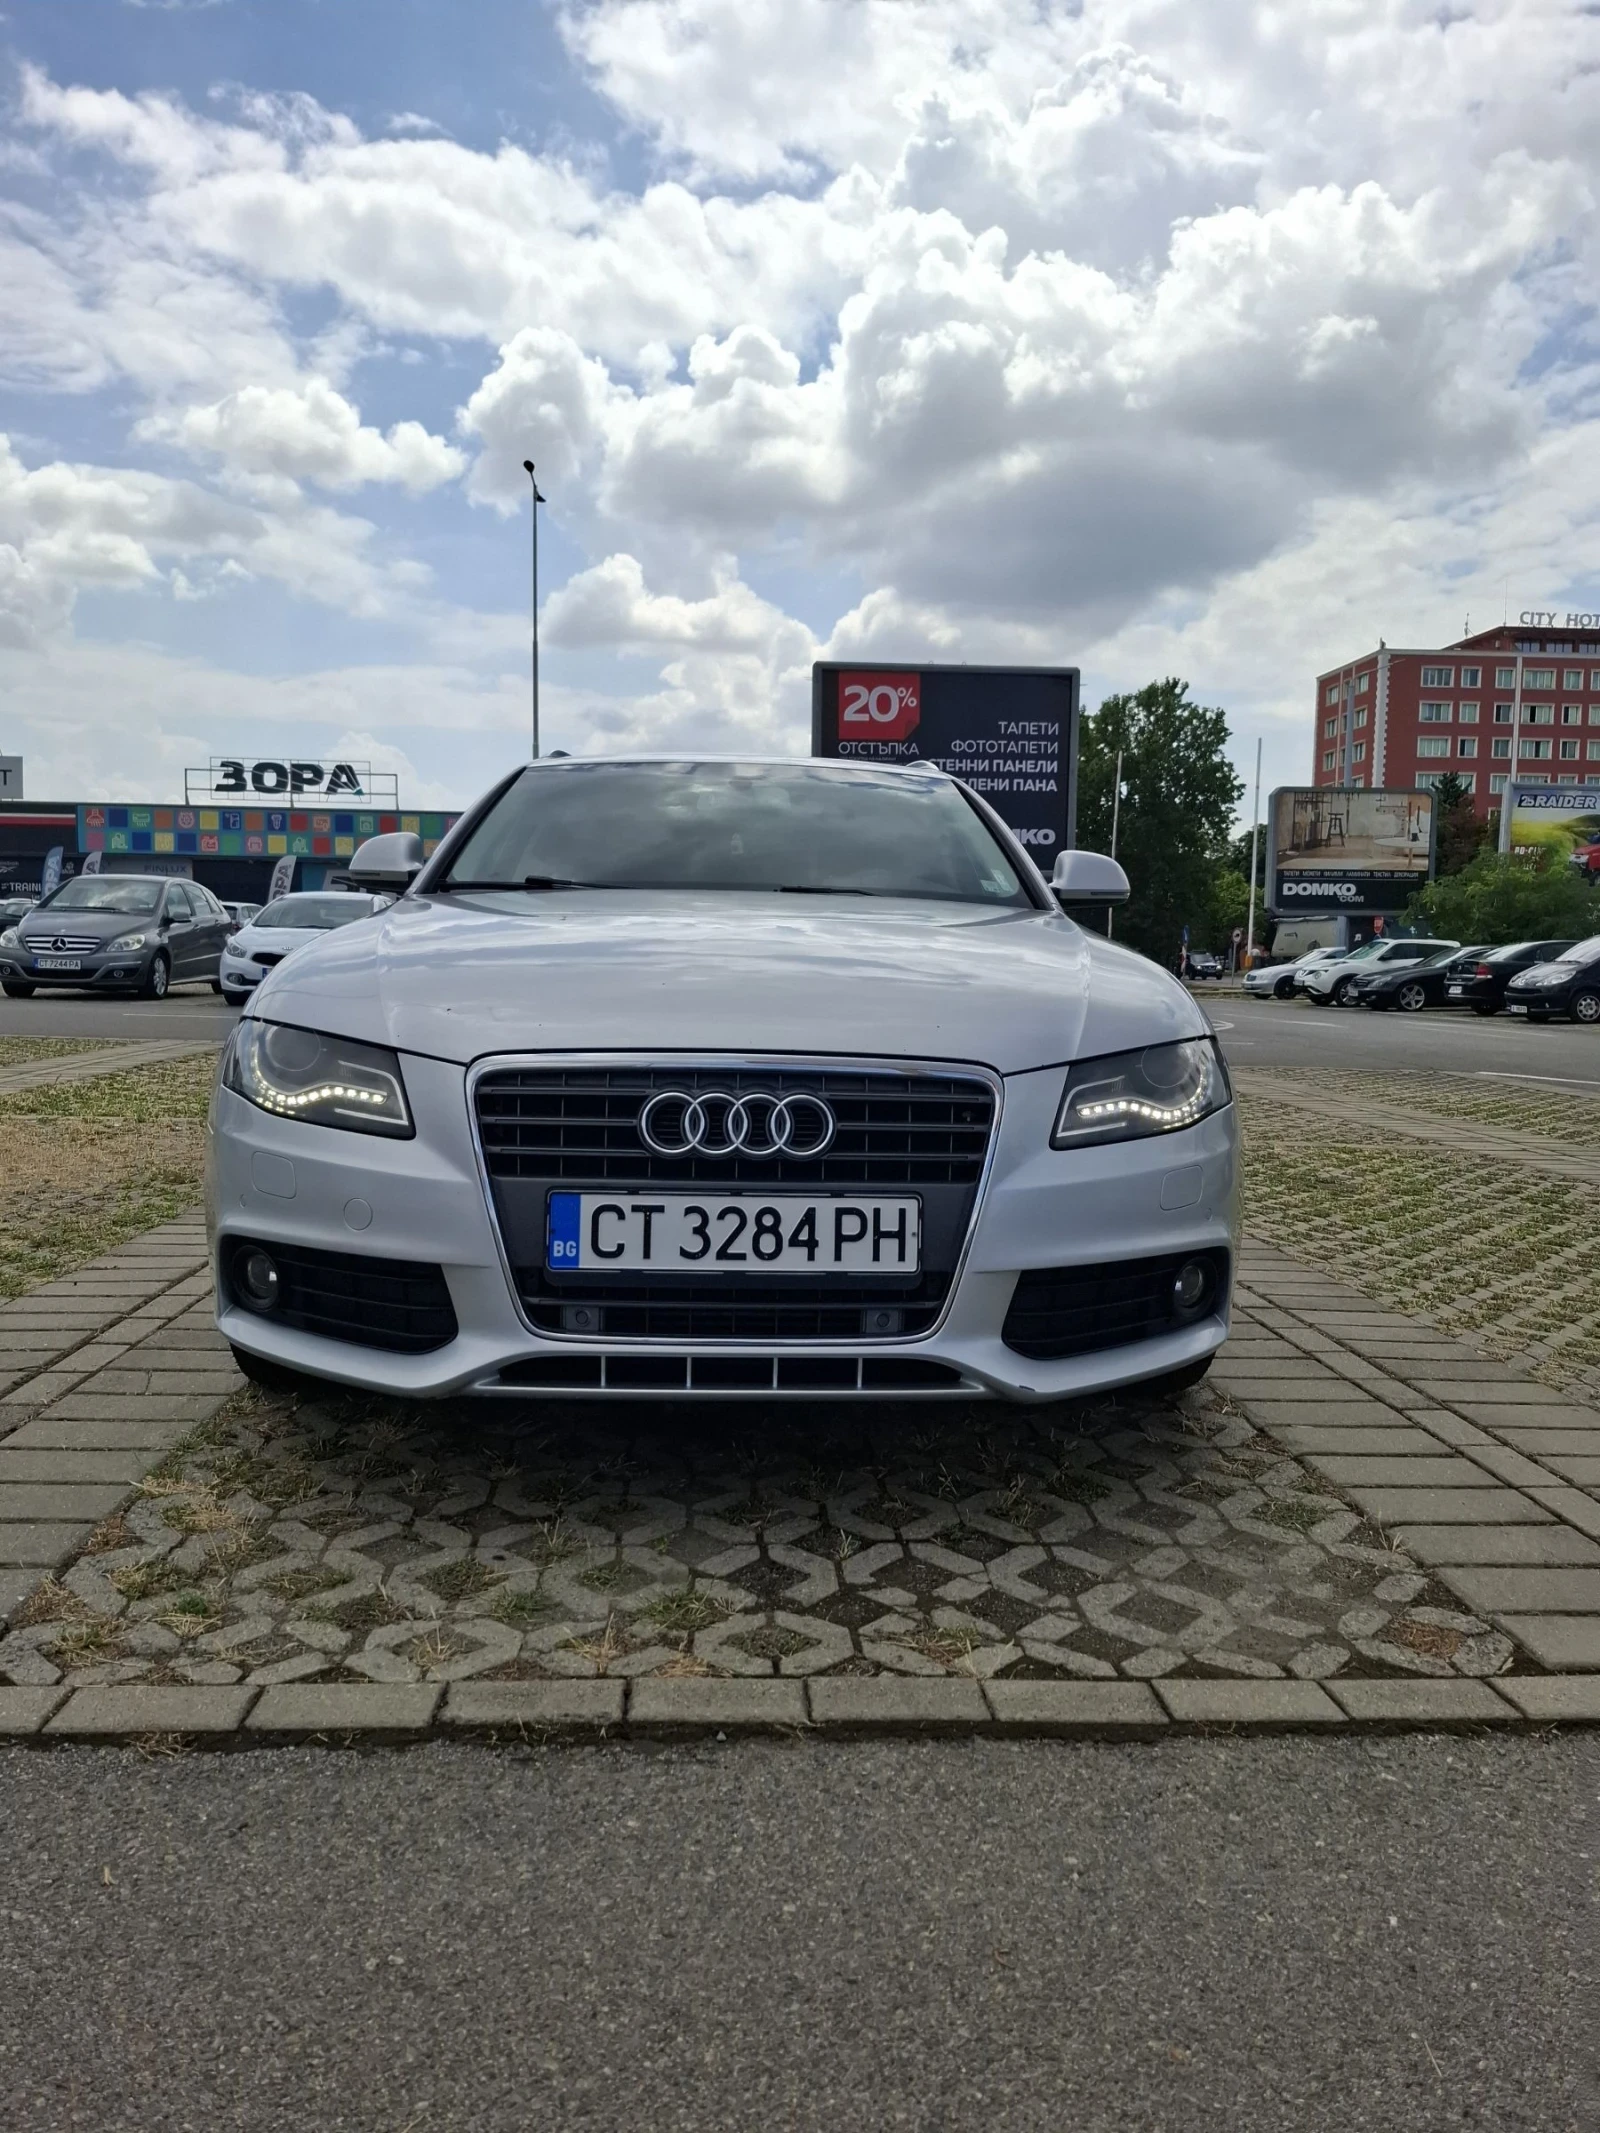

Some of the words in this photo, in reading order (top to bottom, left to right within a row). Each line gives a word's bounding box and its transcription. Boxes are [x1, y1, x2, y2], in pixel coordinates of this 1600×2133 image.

[1519, 611, 1557, 626] CITY
[843, 685, 917, 722] 20%
[998, 721, 1059, 735] ТАПЕТИ
[838, 741, 919, 755] ОТСТЪПКА
[950, 739, 1059, 754] ФОТОТАПЕТИ
[993, 759, 1058, 773] ПАНЕЛИ
[215, 760, 364, 795] ЗОРА
[1013, 779, 1058, 792] ПАНА
[1535, 795, 1597, 808] RAIDER
[144, 863, 187, 873] FINLUX
[1282, 882, 1357, 896] DOMKO
[39, 959, 48, 968] CT
[49, 960, 68, 968] 7244
[69, 960, 79, 969] PA
[590, 1204, 665, 1260] CT
[679, 1206, 819, 1262] 3284
[834, 1207, 906, 1263] PH
[553, 1241, 577, 1258] BG
